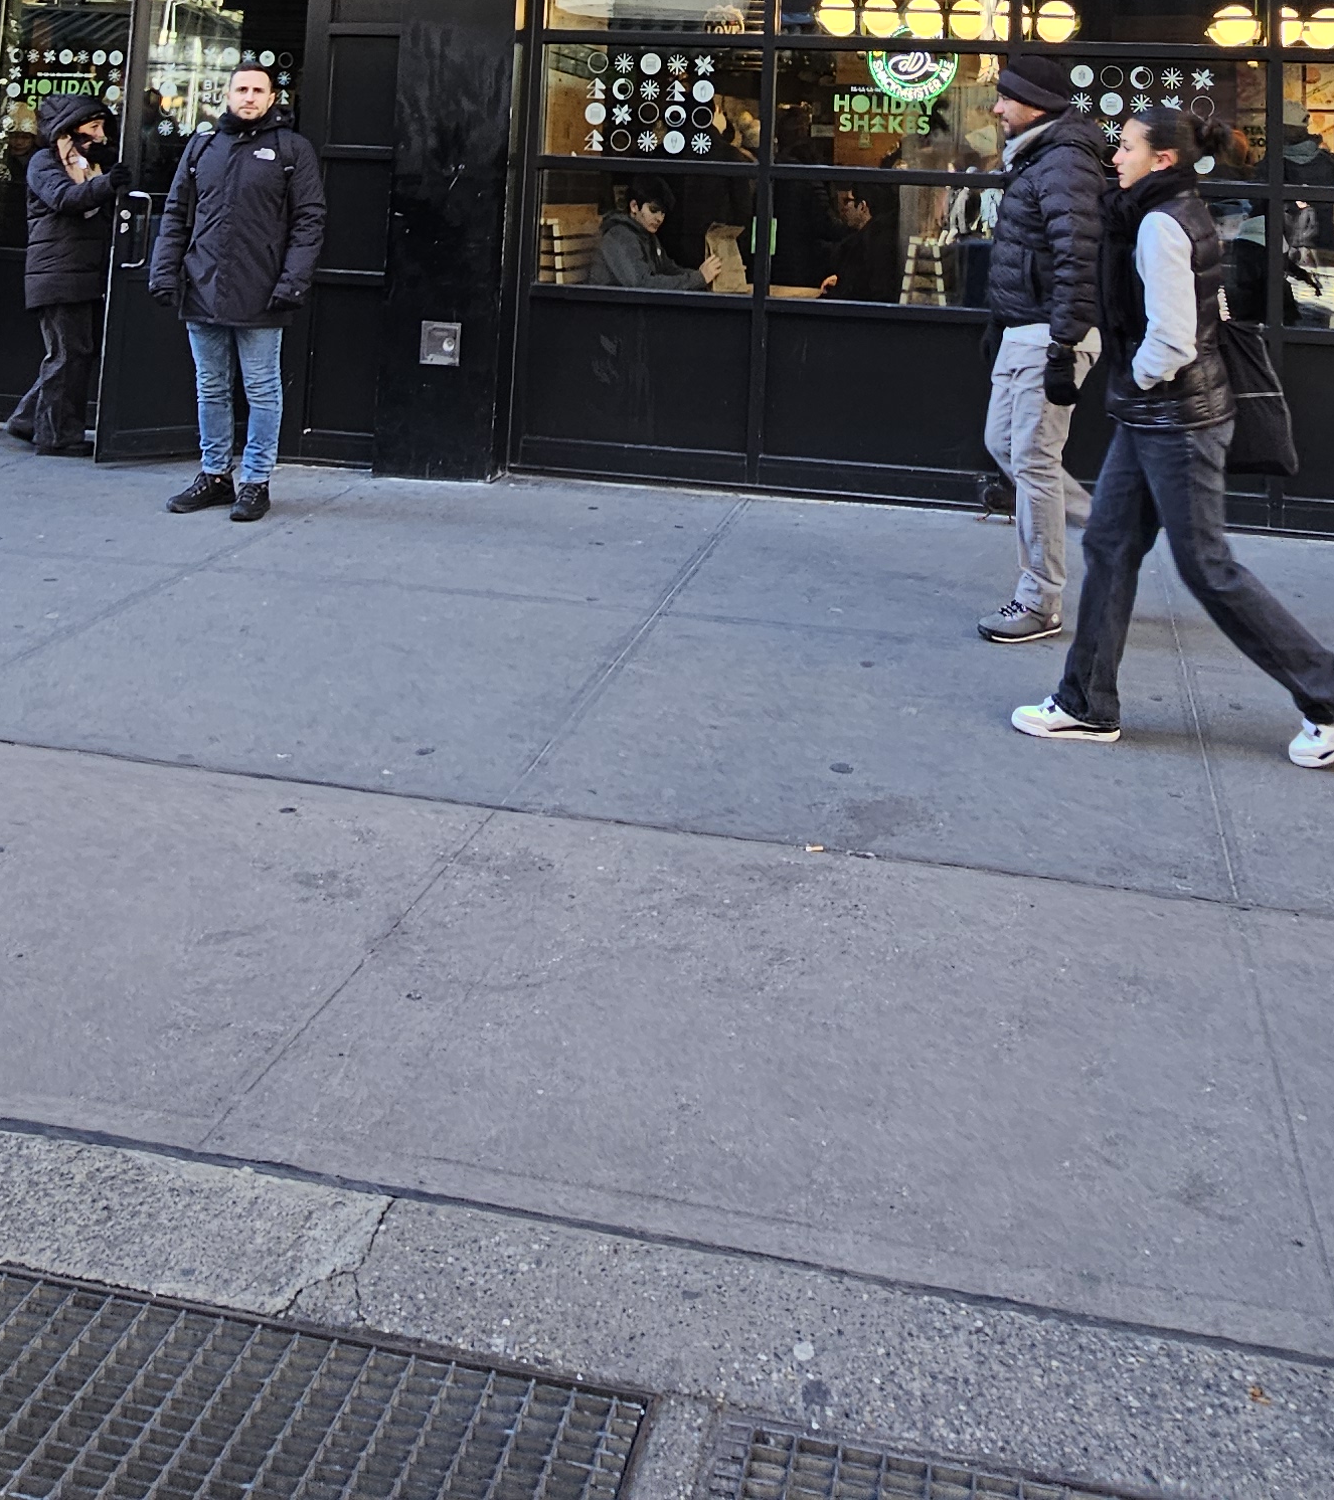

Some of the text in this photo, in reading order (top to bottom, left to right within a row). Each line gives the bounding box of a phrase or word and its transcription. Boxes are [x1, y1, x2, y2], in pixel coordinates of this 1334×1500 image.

[23, 78, 104, 96] HOLIDAY
[833, 94, 938, 115] HOLIDAY
[838, 113, 931, 135] SHAKES
